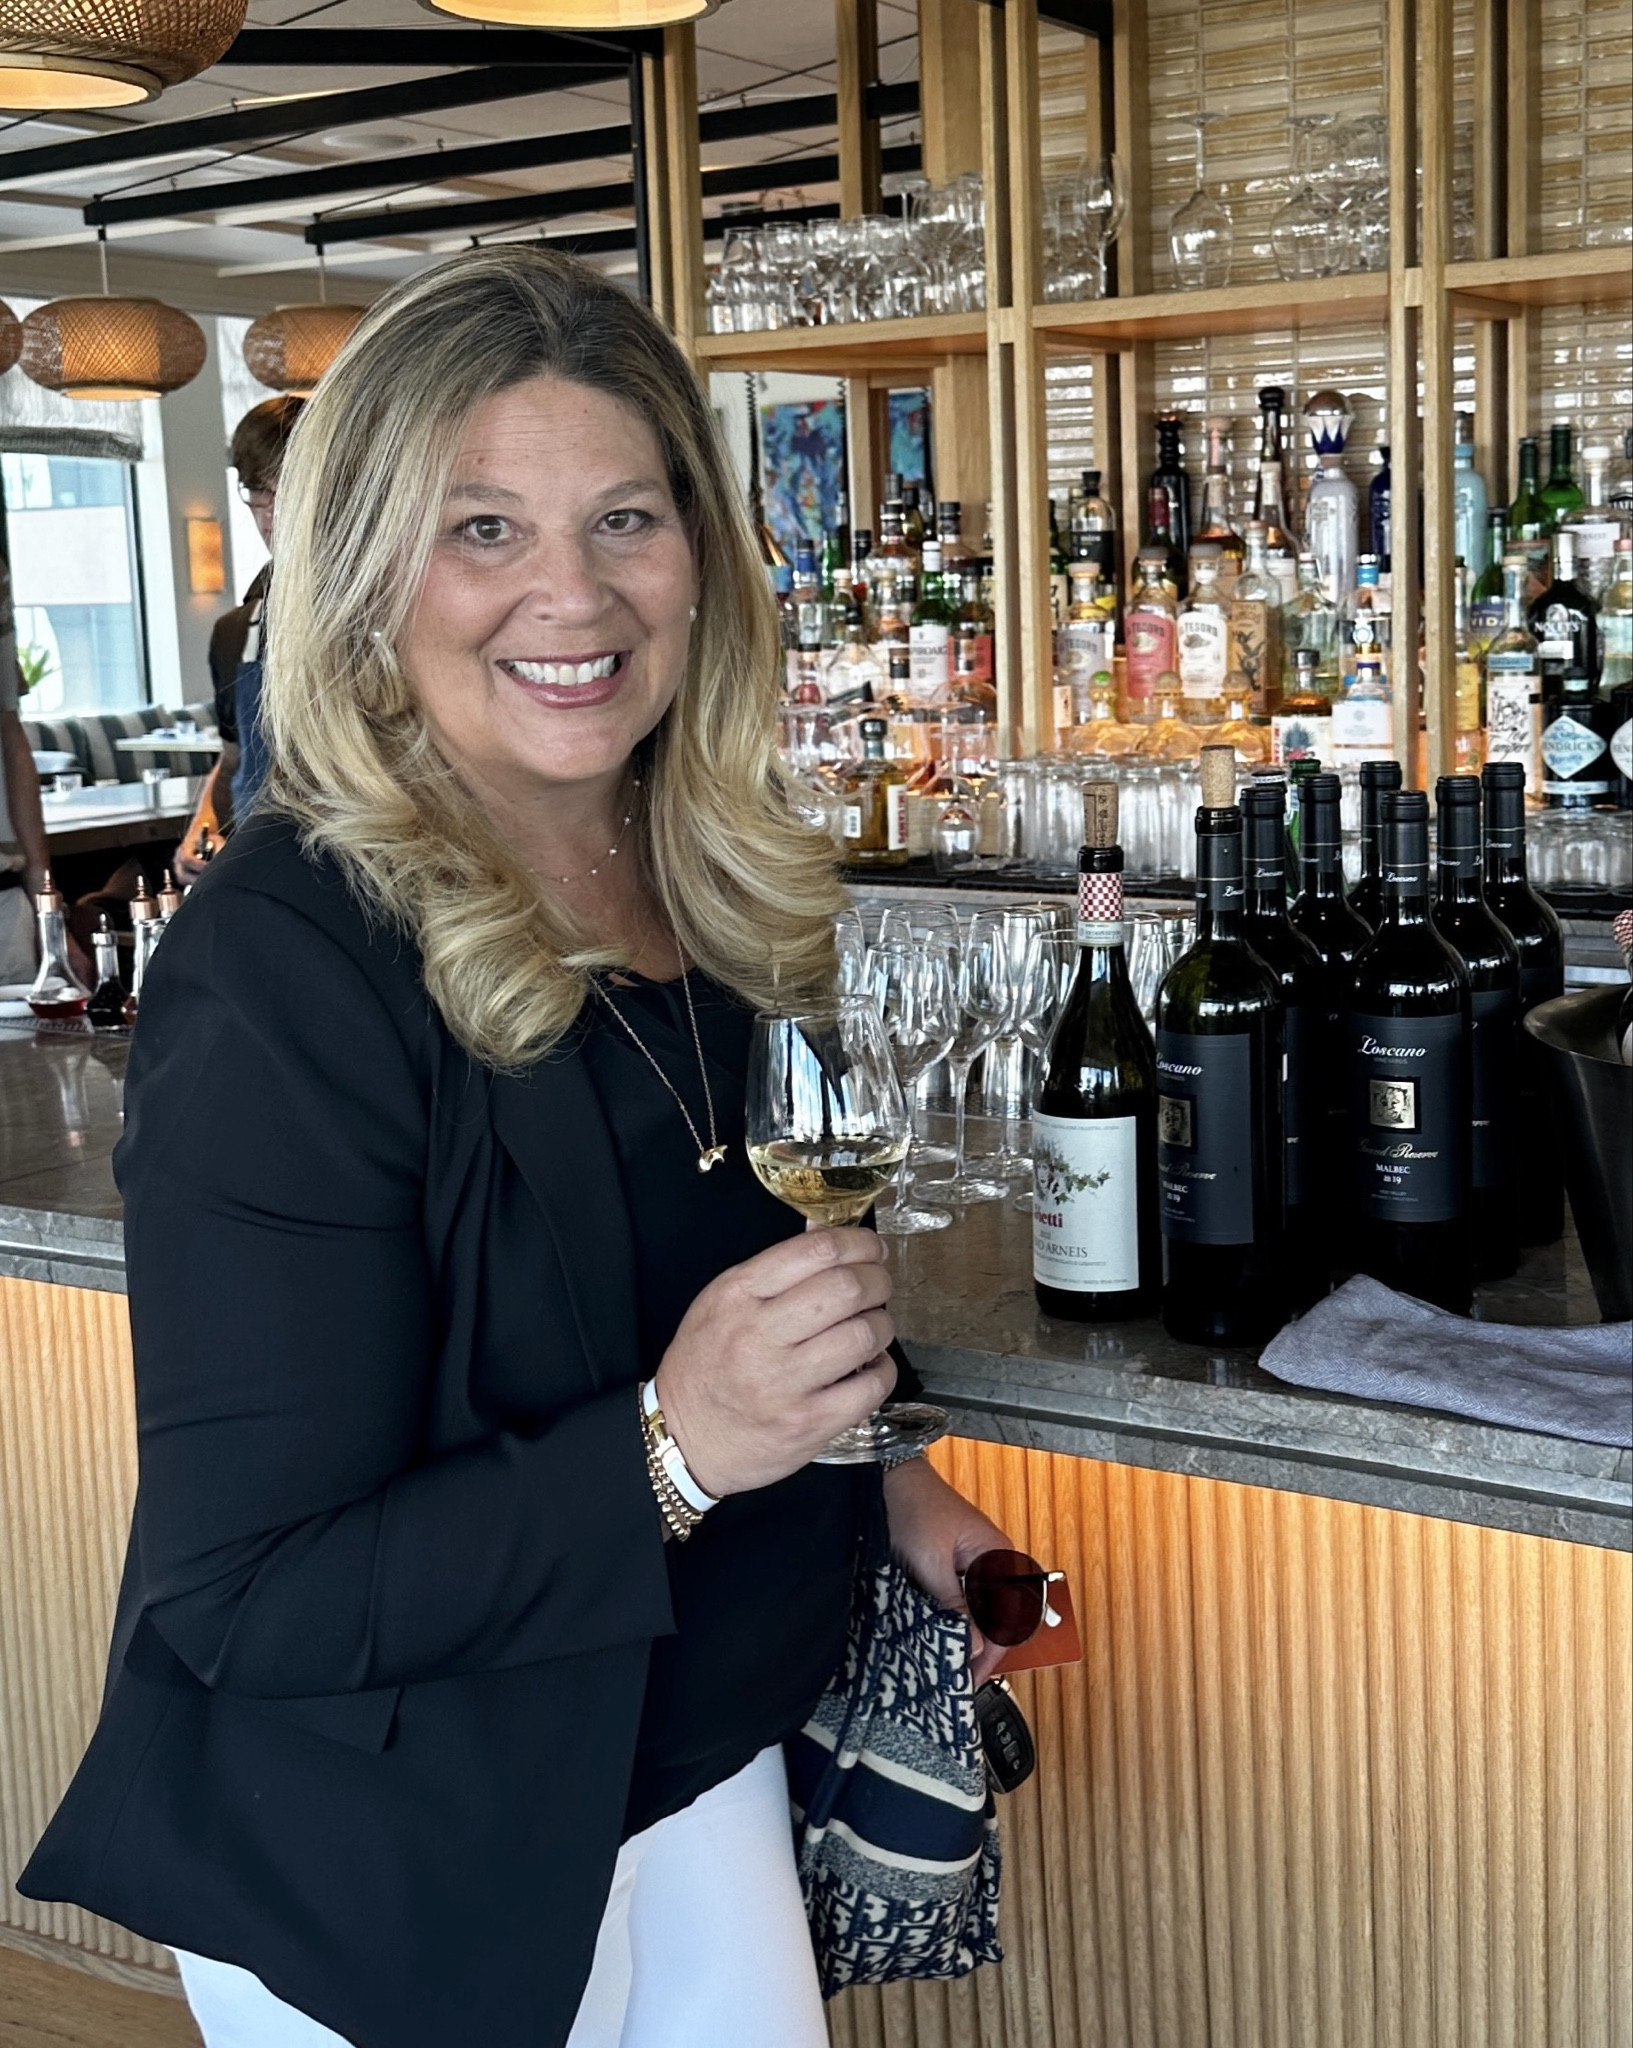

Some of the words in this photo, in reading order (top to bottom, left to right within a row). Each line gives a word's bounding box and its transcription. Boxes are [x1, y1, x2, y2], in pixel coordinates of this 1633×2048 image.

[1541, 740, 1604, 753] ENDRICK'S
[1357, 1035, 1426, 1057] Loscano
[1376, 1163, 1411, 1174] MALBEC
[1046, 1242, 1088, 1258] ARNEIS
